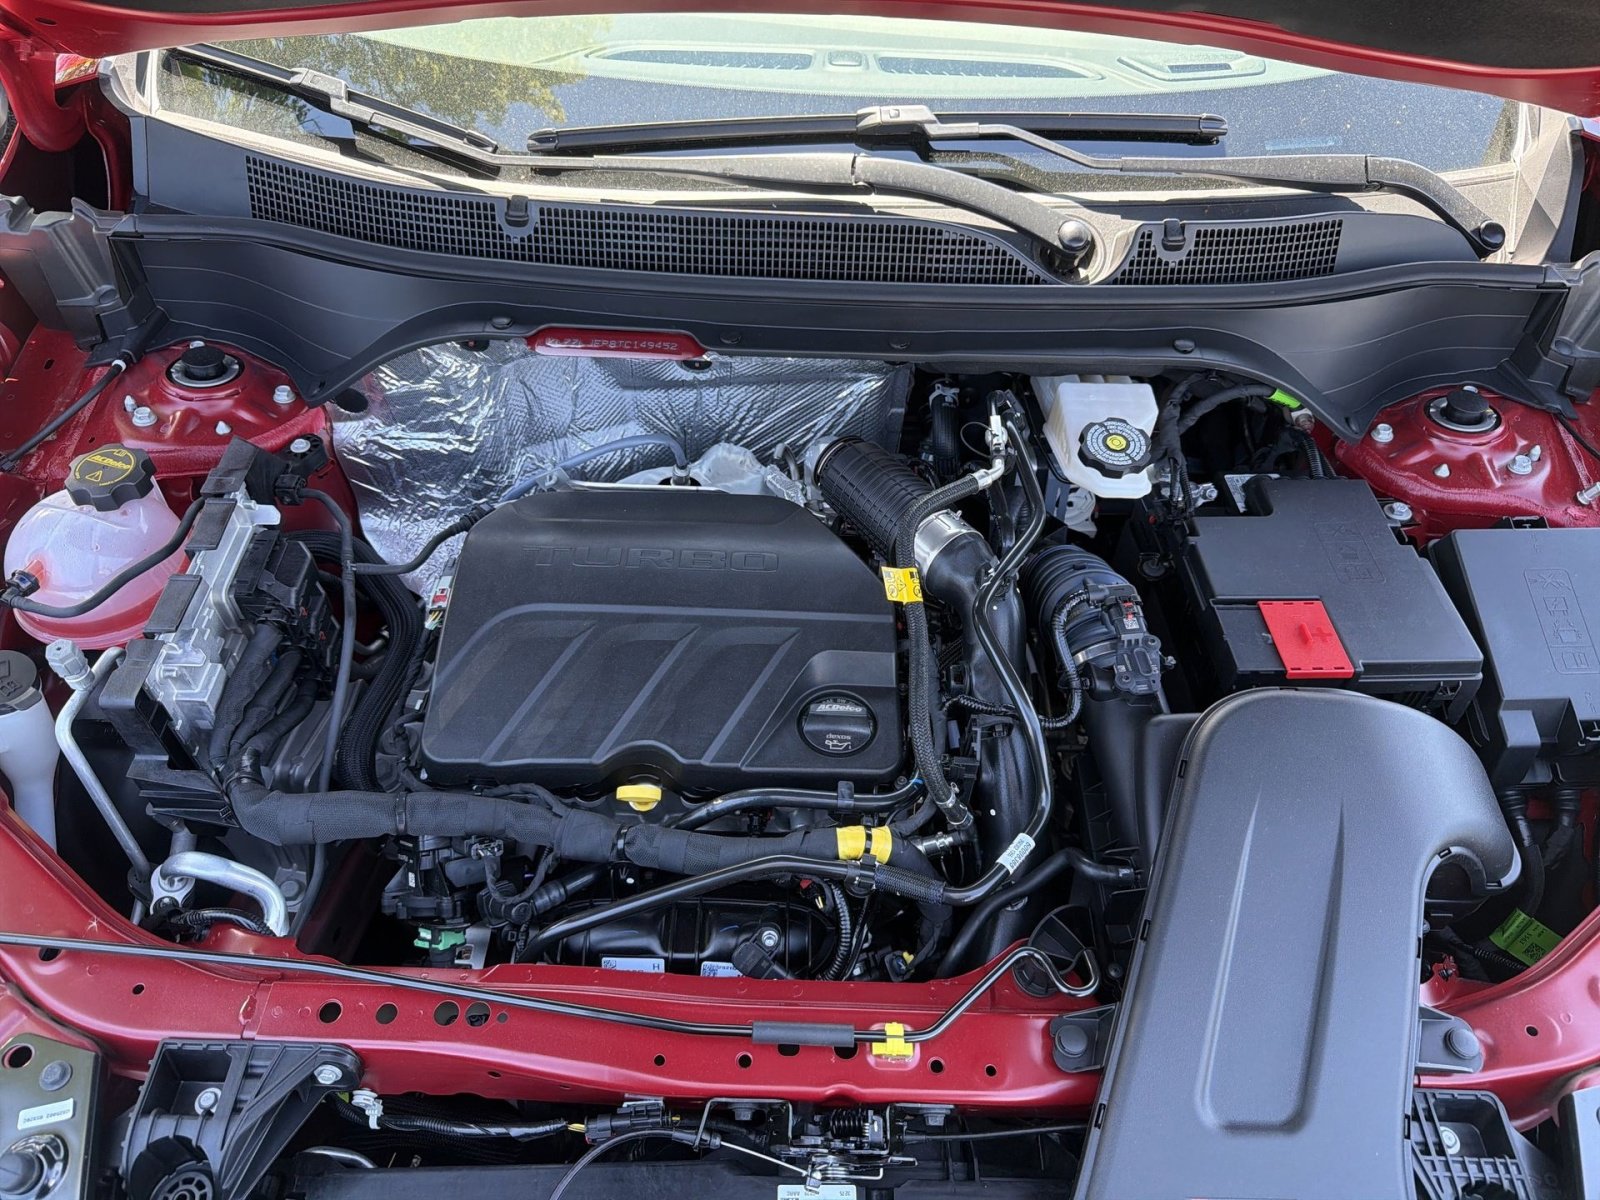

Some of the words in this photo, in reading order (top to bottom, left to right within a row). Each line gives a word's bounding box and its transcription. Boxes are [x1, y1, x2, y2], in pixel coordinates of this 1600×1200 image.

[88, 454, 132, 471] ACDelco
[521, 546, 780, 572] TURBO
[815, 704, 863, 713] ACDelco
[652, 963, 660, 971] H
